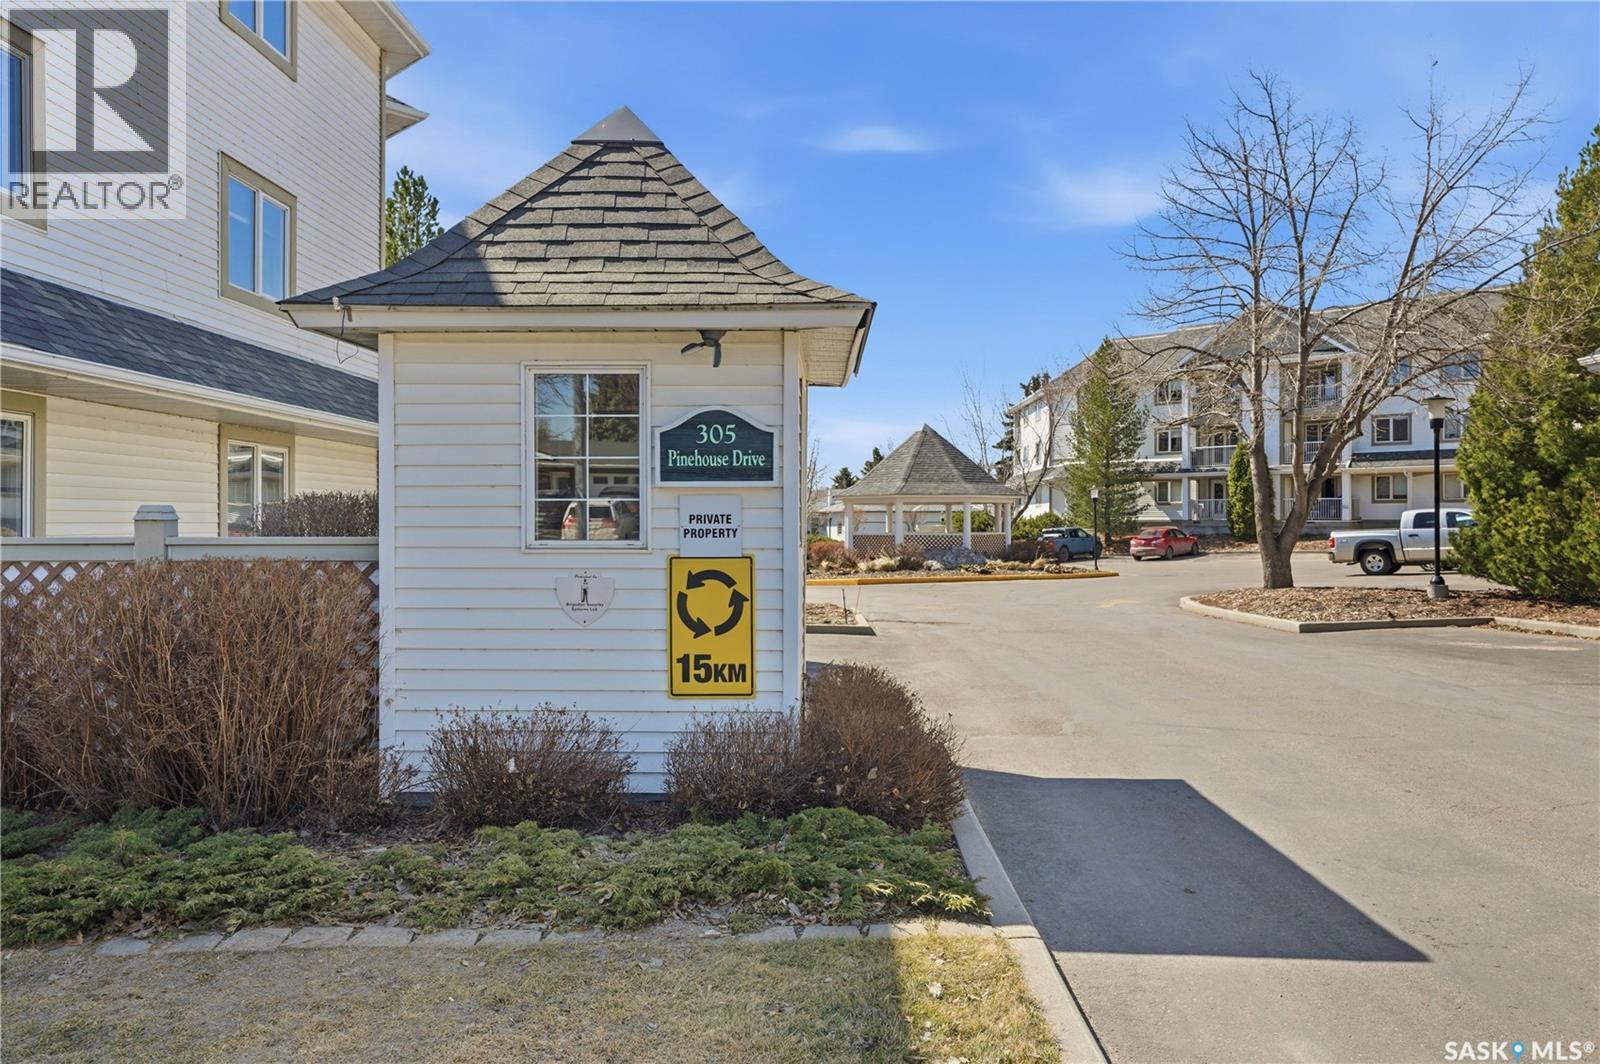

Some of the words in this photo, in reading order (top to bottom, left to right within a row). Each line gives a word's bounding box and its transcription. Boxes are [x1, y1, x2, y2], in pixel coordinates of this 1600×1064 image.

[695, 424, 736, 444] 305
[668, 449, 729, 467] Pinehouse
[732, 449, 766, 467] Drive
[689, 514, 732, 525] PRIVATE
[683, 528, 738, 539] PROPERTY
[676, 653, 747, 684] 15KM
